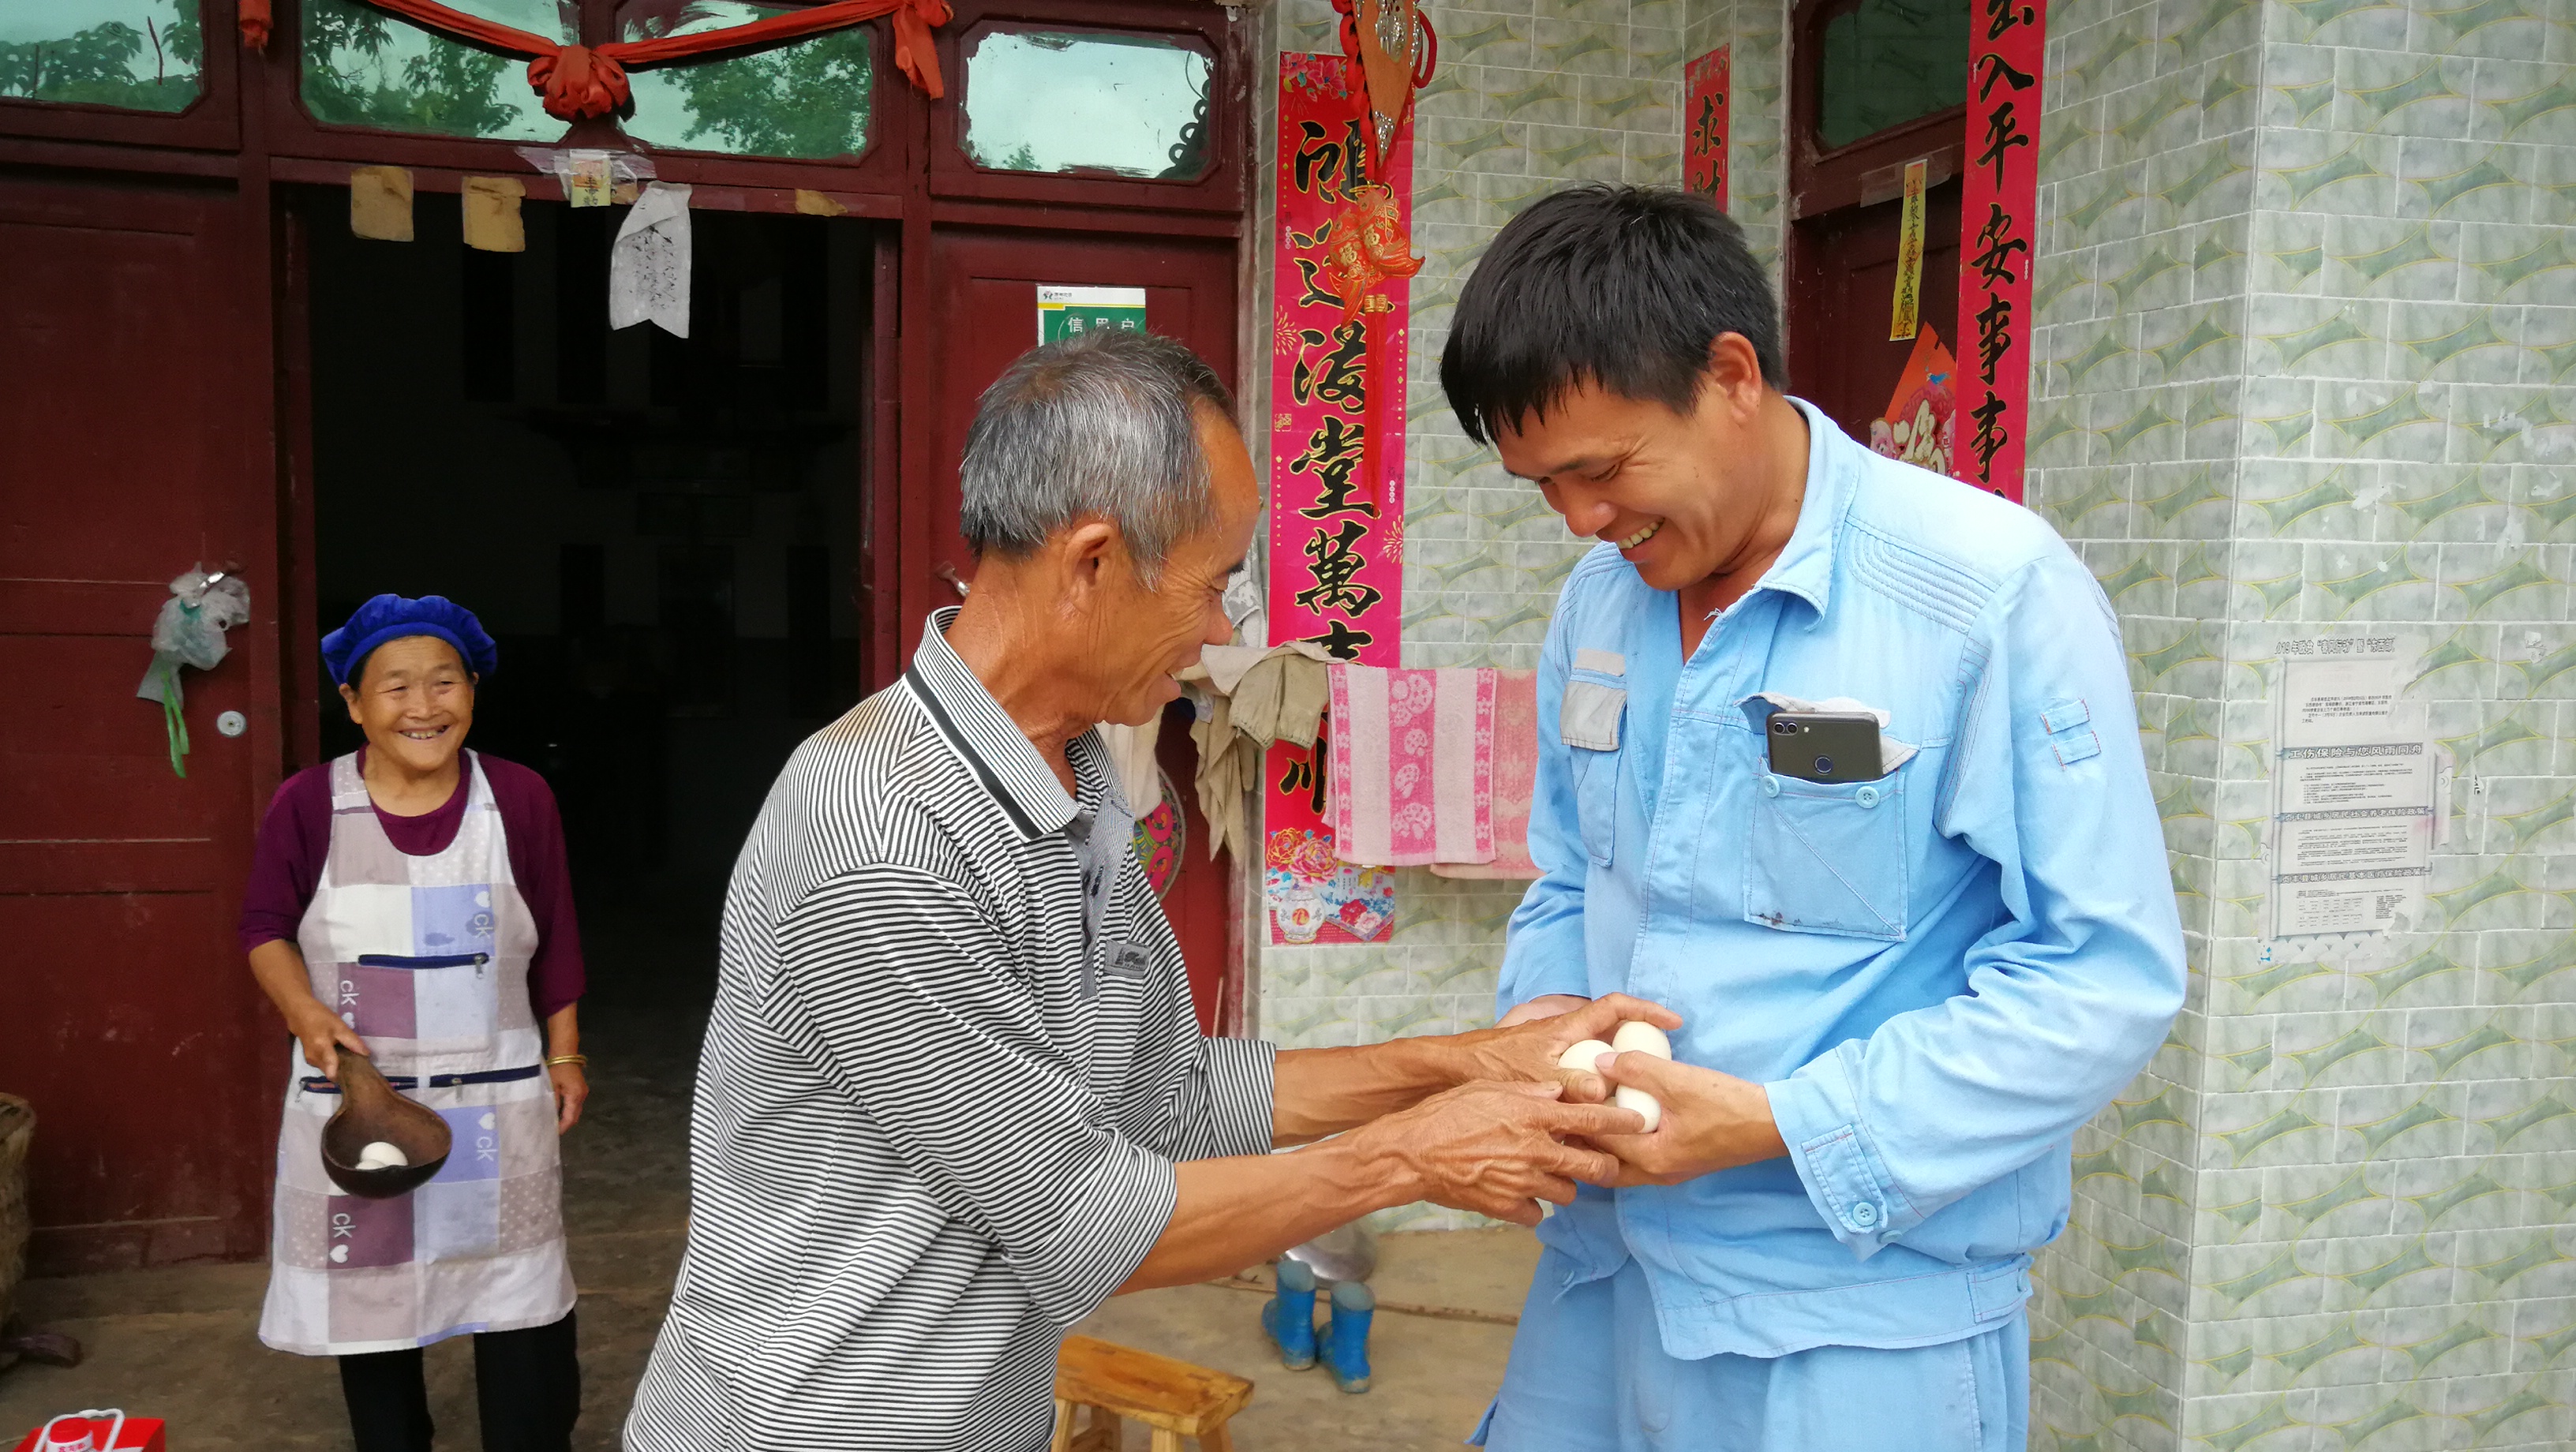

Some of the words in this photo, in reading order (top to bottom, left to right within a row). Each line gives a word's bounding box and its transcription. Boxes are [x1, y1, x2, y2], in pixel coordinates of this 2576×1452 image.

[1969, 0, 2035, 499] 出入平安事事
[2289, 745, 2423, 759] 工伤保险与您风雨同舟
[2284, 807, 2426, 821] 贞丰县城乡居民社会养老保险政策
